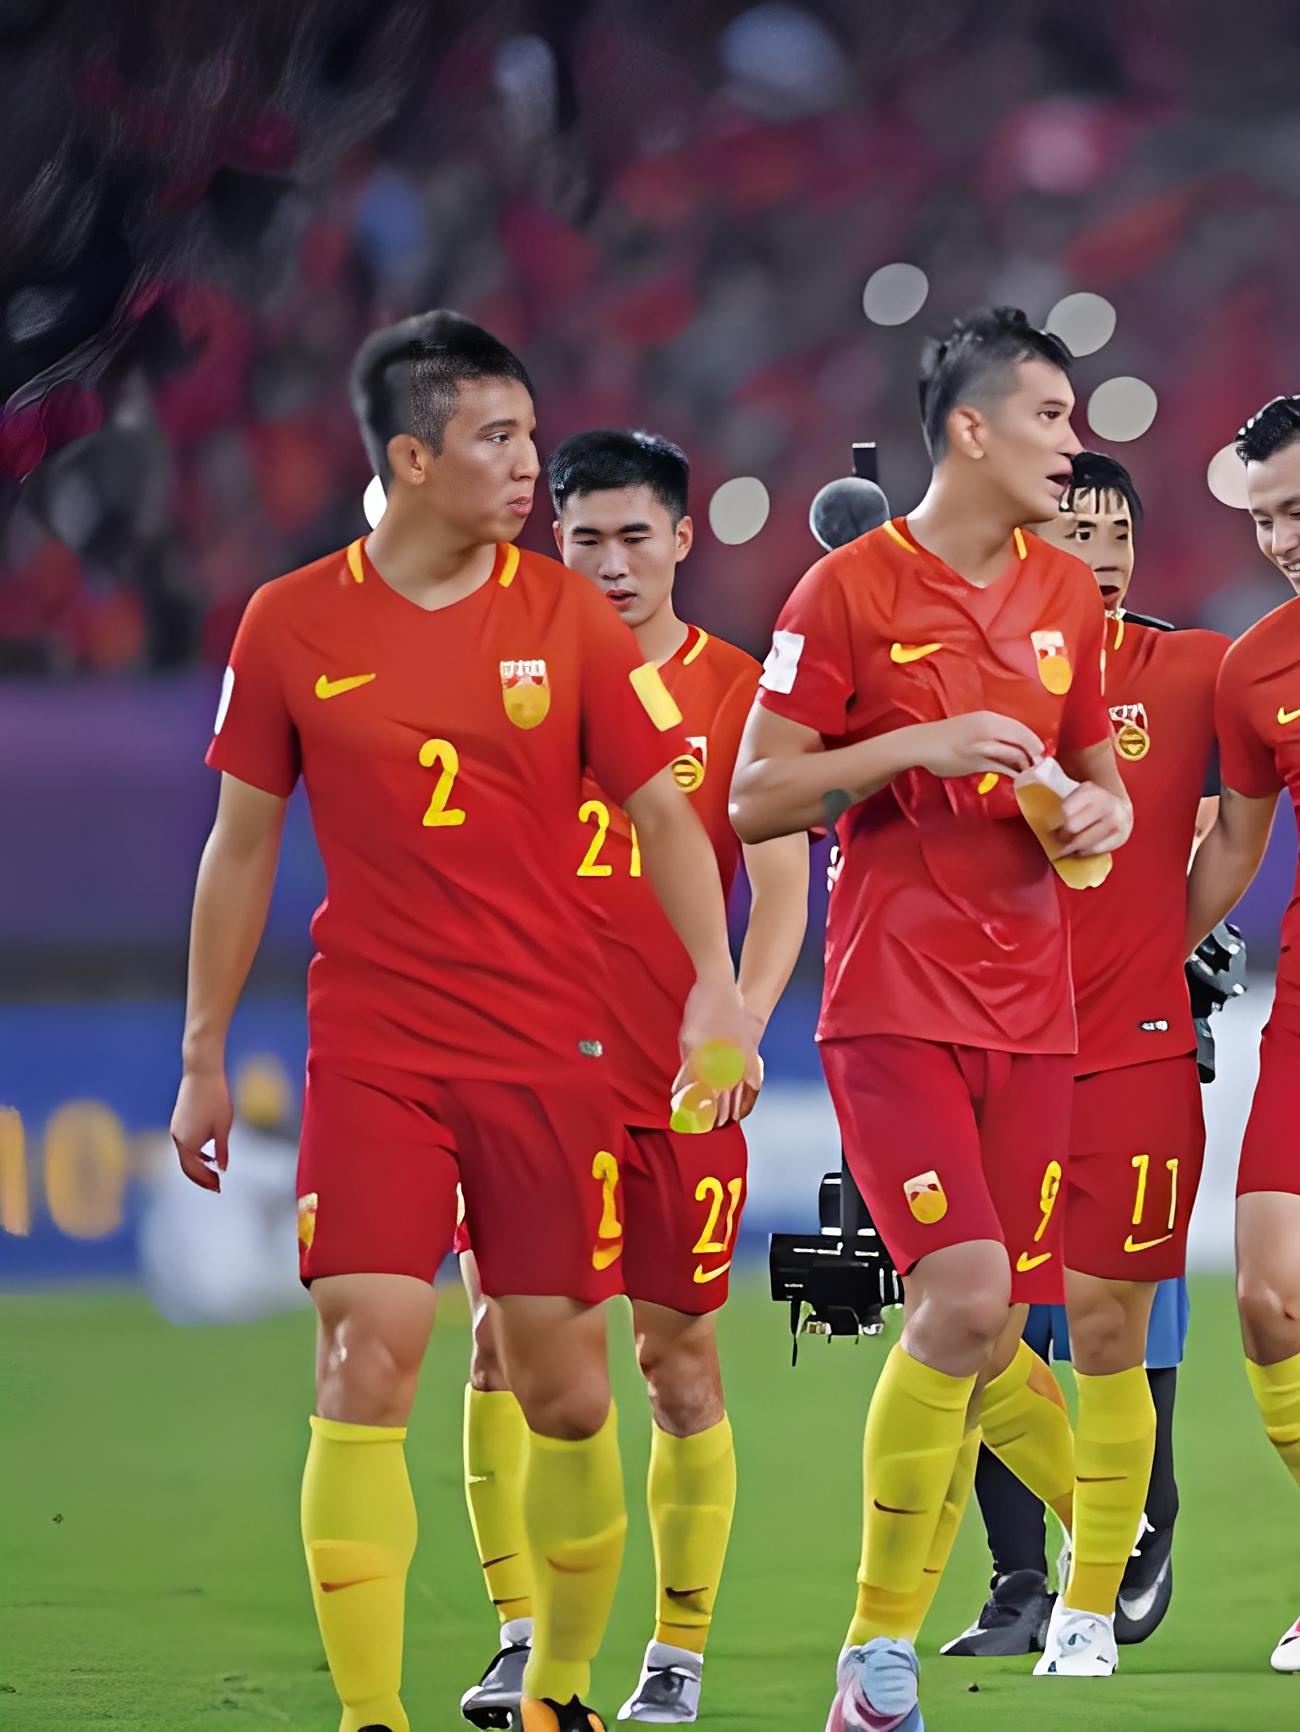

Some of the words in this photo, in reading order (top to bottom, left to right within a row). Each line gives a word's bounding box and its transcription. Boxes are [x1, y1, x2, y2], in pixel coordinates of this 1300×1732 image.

[418, 738, 466, 827] 2
[691, 1175, 743, 1254] 21
[1033, 1159, 1063, 1242] 9
[1130, 1153, 1180, 1231] 11
